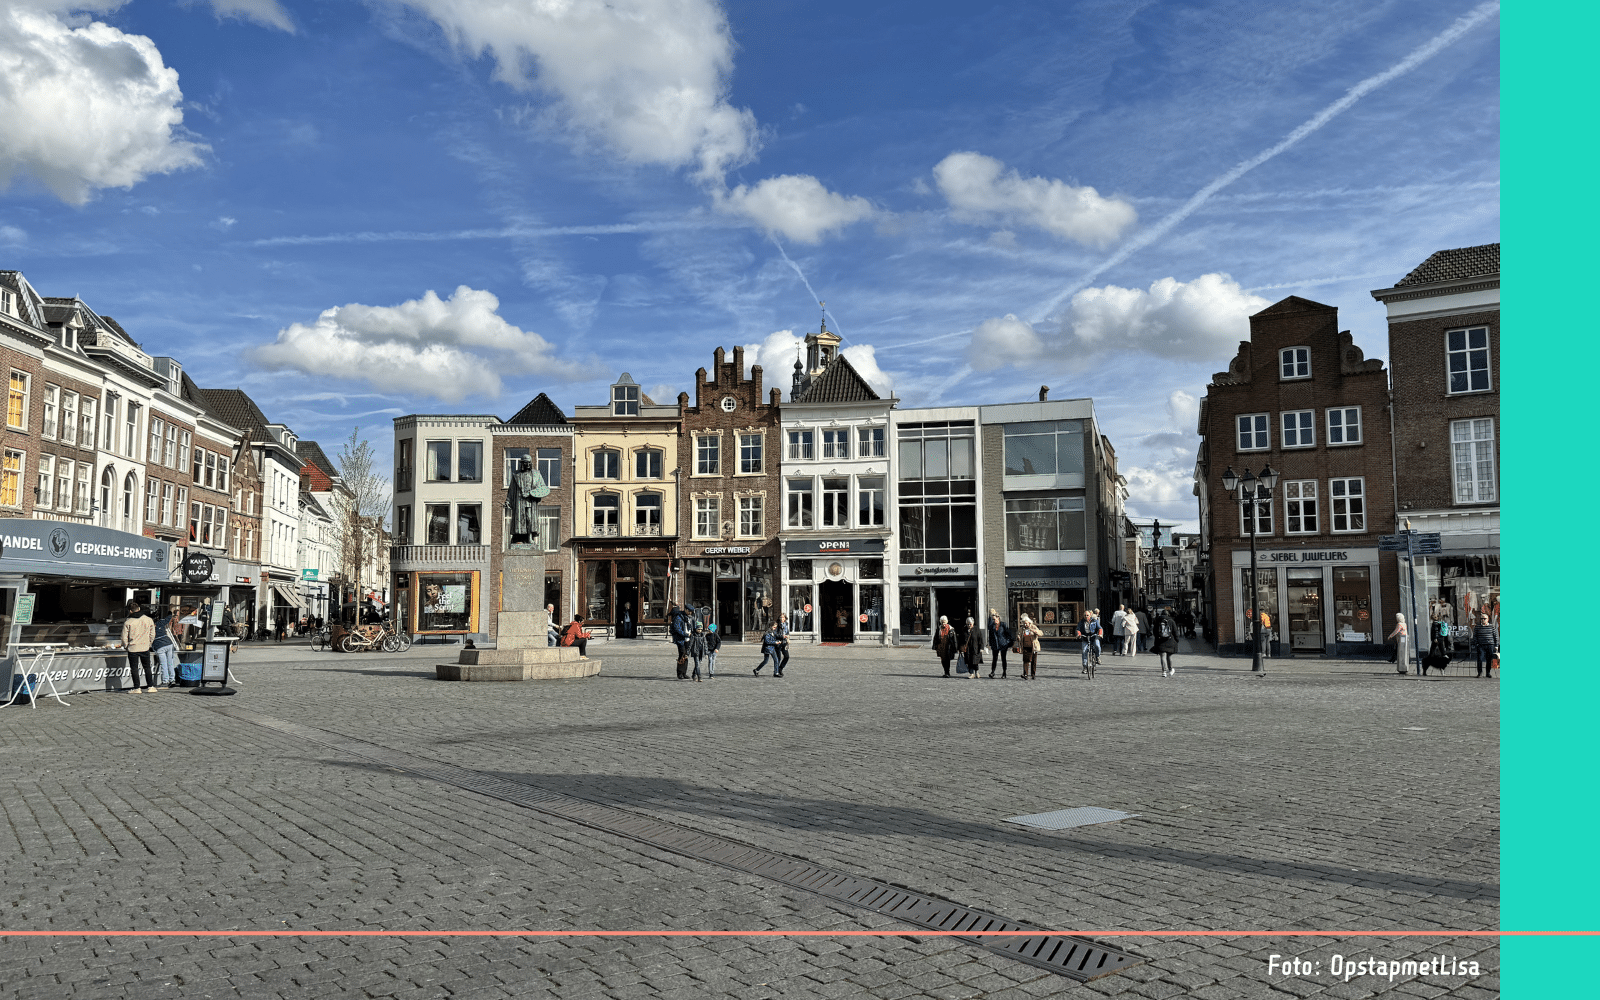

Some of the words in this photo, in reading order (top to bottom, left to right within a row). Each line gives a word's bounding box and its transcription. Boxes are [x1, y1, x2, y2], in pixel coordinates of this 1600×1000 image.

[74, 541, 153, 560] GEPKENS-ERNST
[1271, 552, 1298, 562] SIEBEL
[1301, 551, 1348, 562] JUWELIERS
[50, 669, 69, 680] zee
[72, 667, 93, 679] van
